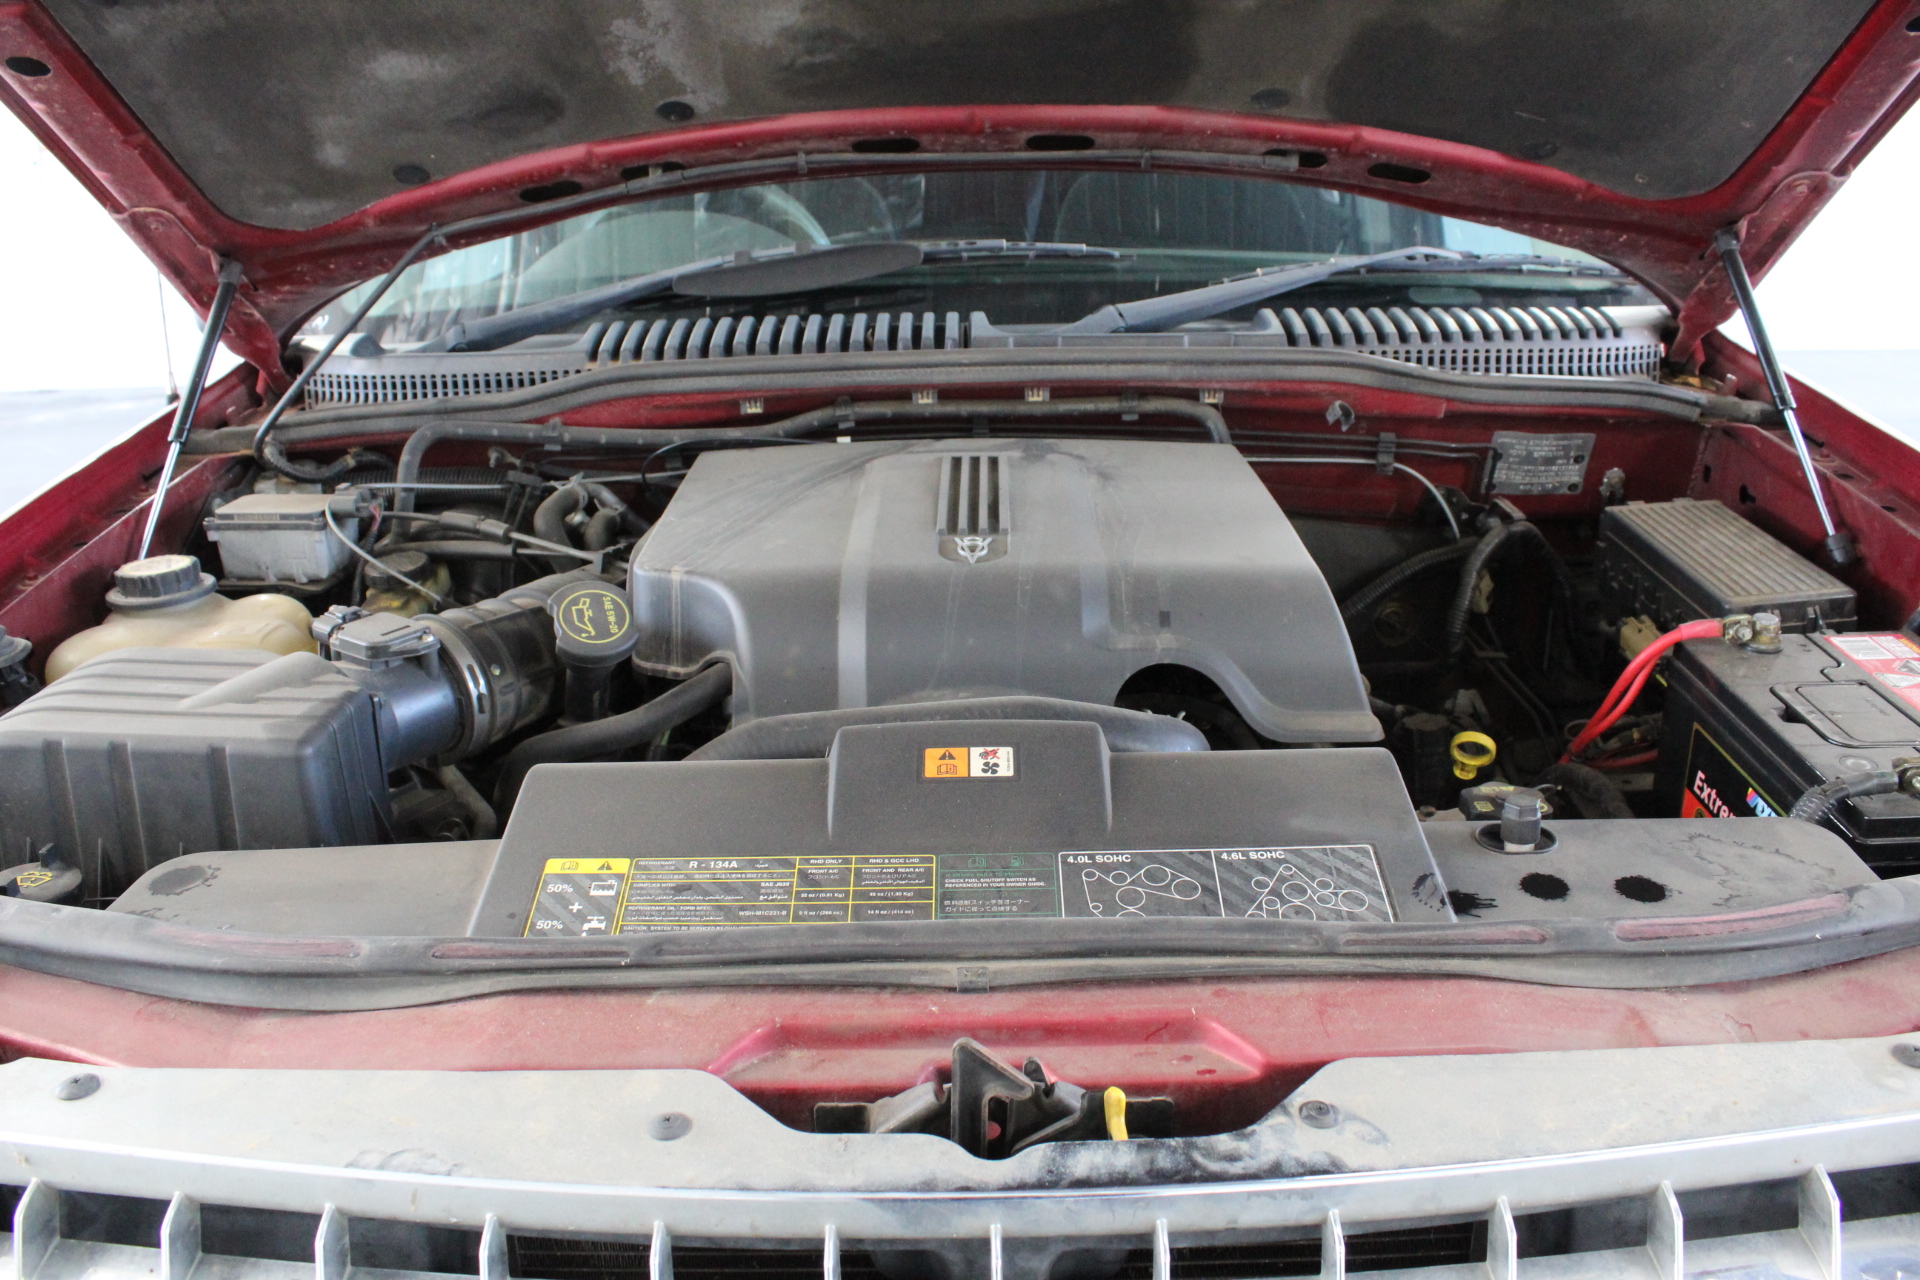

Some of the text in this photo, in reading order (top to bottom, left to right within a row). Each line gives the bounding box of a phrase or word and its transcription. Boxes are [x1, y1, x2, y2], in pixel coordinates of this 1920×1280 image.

[602, 596, 619, 633] SAE 5W-20
[1067, 854, 1132, 864] 4.0L SOHC
[1221, 850, 1286, 860] 4.6L SOHC
[689, 861, 698, 869] R
[709, 860, 738, 869] 134A
[546, 884, 574, 893] 50%
[535, 920, 564, 930] 50%
